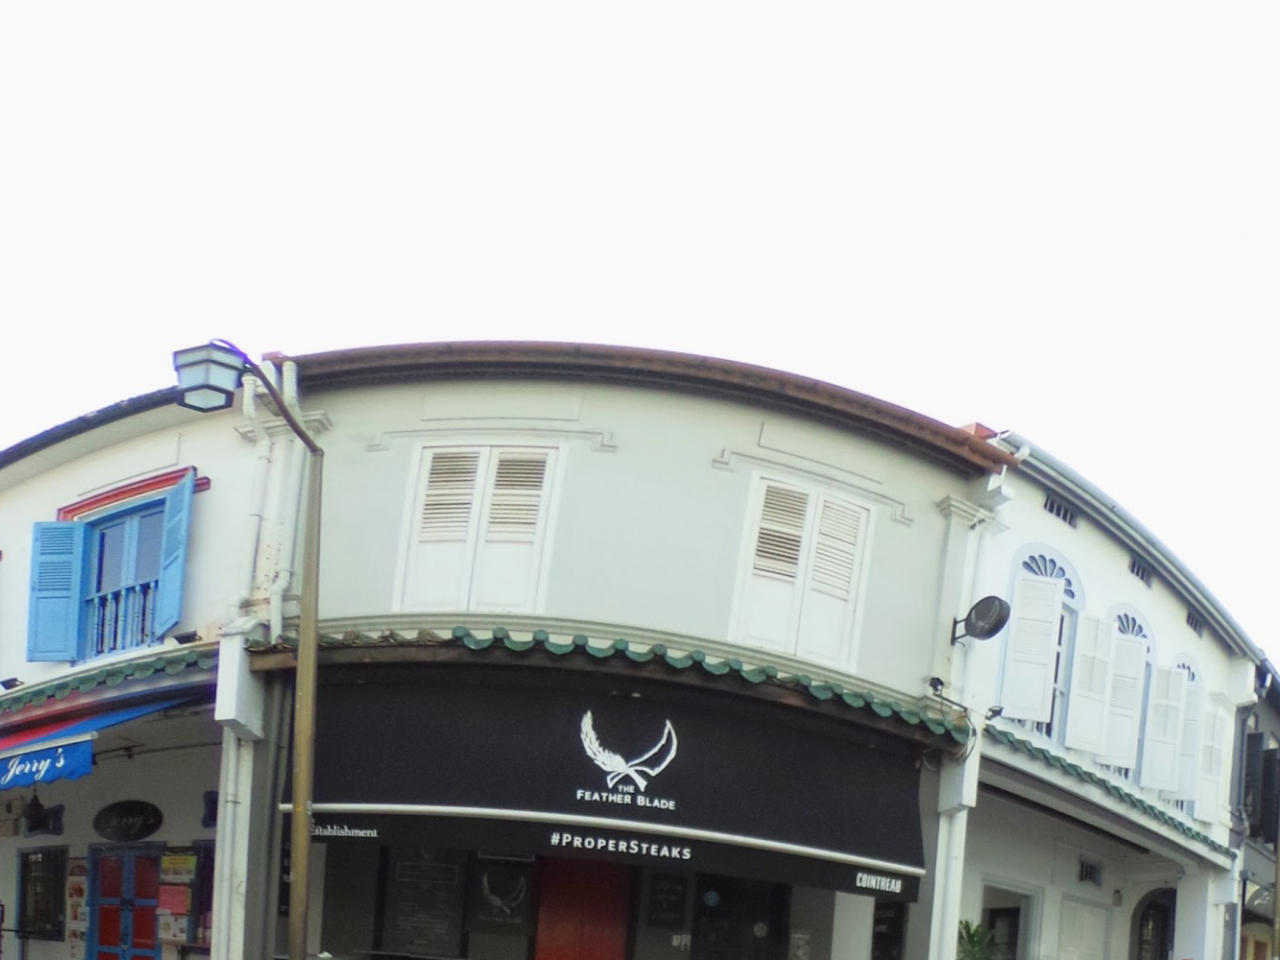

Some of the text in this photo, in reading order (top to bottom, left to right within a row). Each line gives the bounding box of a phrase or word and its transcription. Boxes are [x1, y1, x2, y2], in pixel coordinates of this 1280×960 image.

[1, 747, 65, 785] Jerry's
[618, 785, 635, 793] THE
[855, 872, 902, 894] COINTREAU
